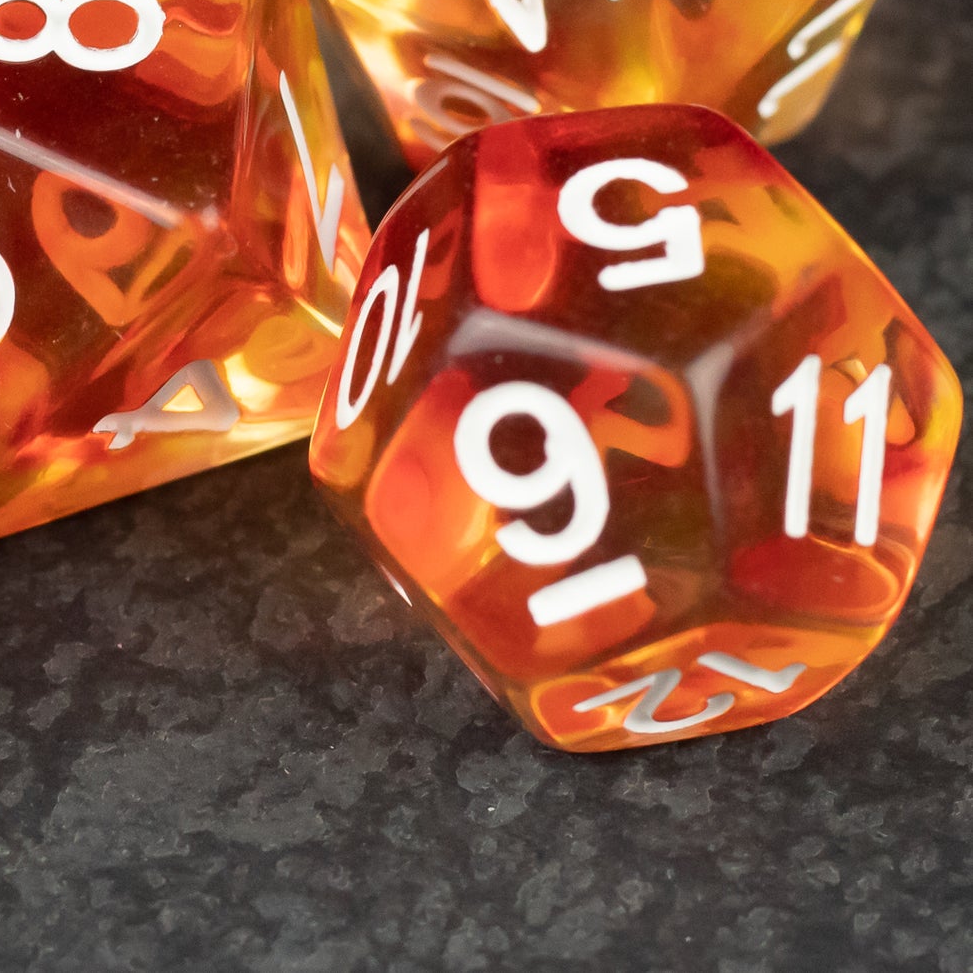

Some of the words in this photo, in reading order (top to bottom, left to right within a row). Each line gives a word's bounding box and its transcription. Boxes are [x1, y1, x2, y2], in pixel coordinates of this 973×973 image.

[557, 157, 705, 292] 5
[92, 359, 240, 450] 4
[335, 228, 430, 431] 10
[453, 380, 648, 627] 9
[771, 354, 893, 548] 11
[573, 651, 807, 734] 12
